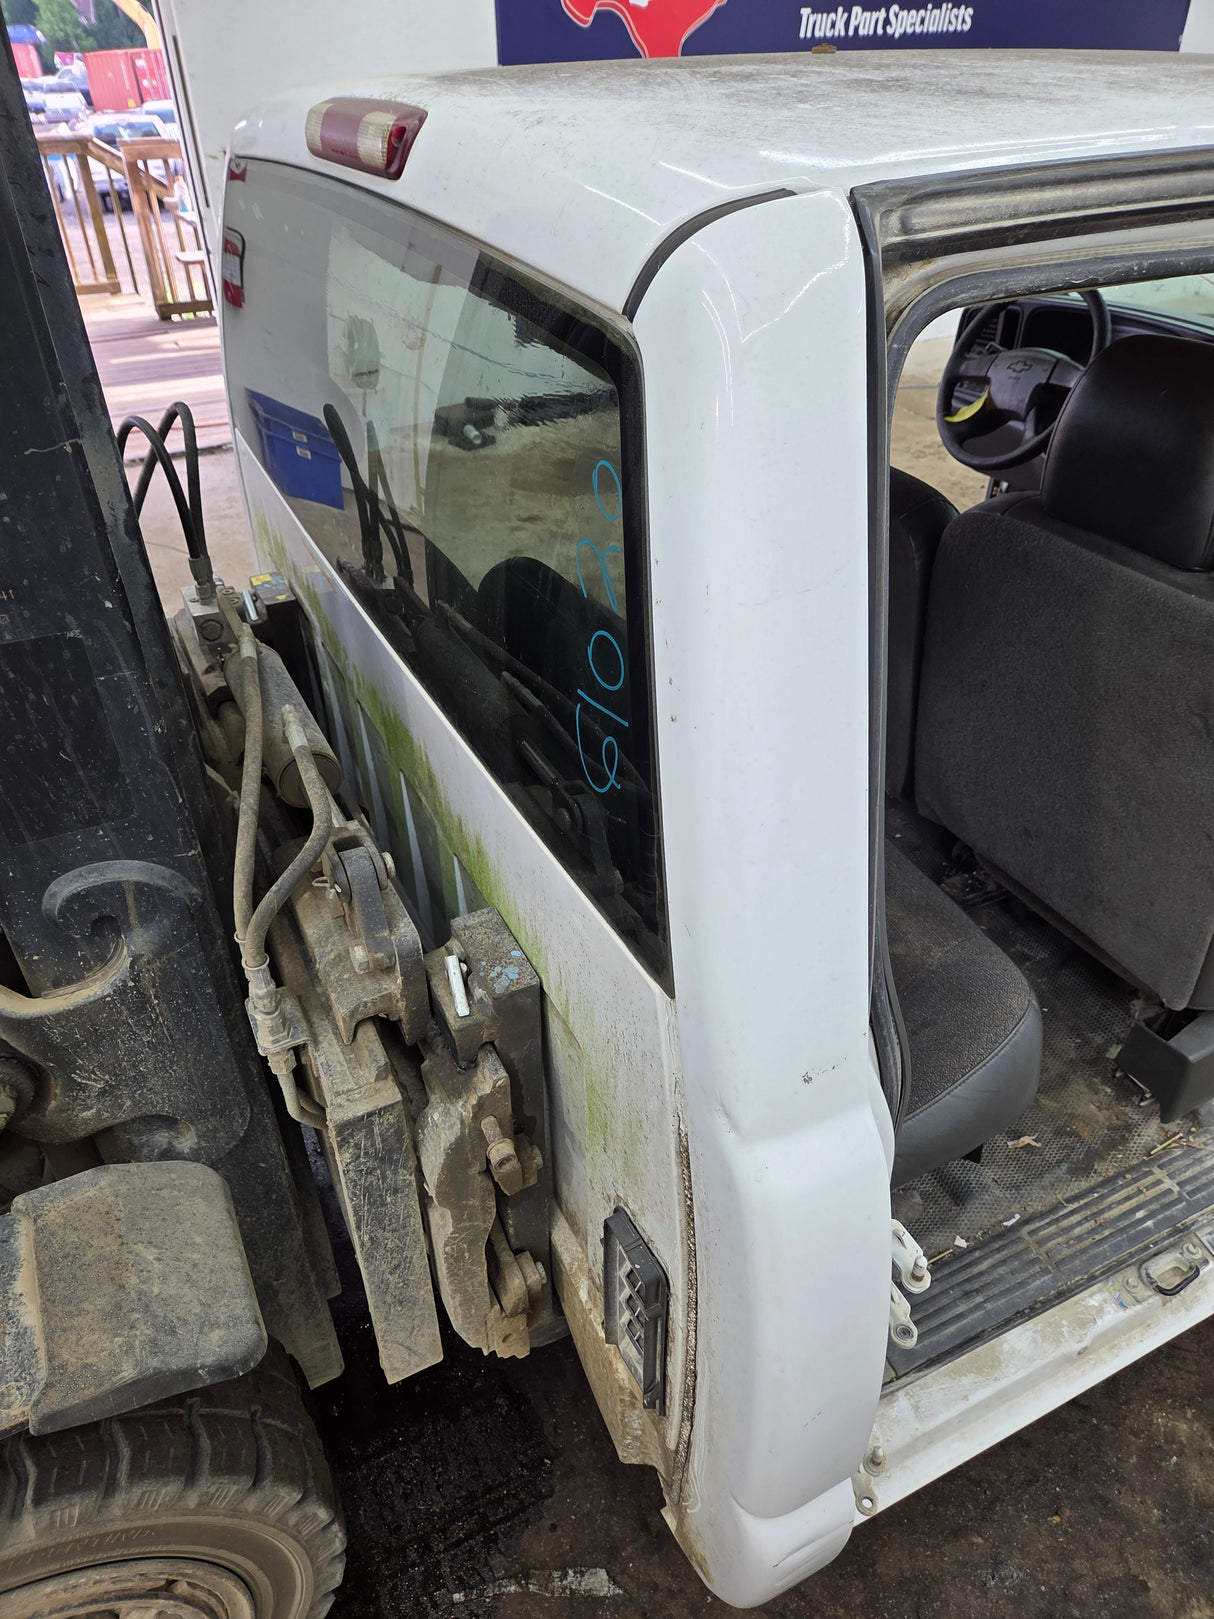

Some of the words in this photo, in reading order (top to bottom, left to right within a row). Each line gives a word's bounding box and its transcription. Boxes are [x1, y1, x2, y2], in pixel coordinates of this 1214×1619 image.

[799, 6, 848, 39] Truck
[848, 5, 887, 37] Part
[886, 2, 974, 40] Specialists
